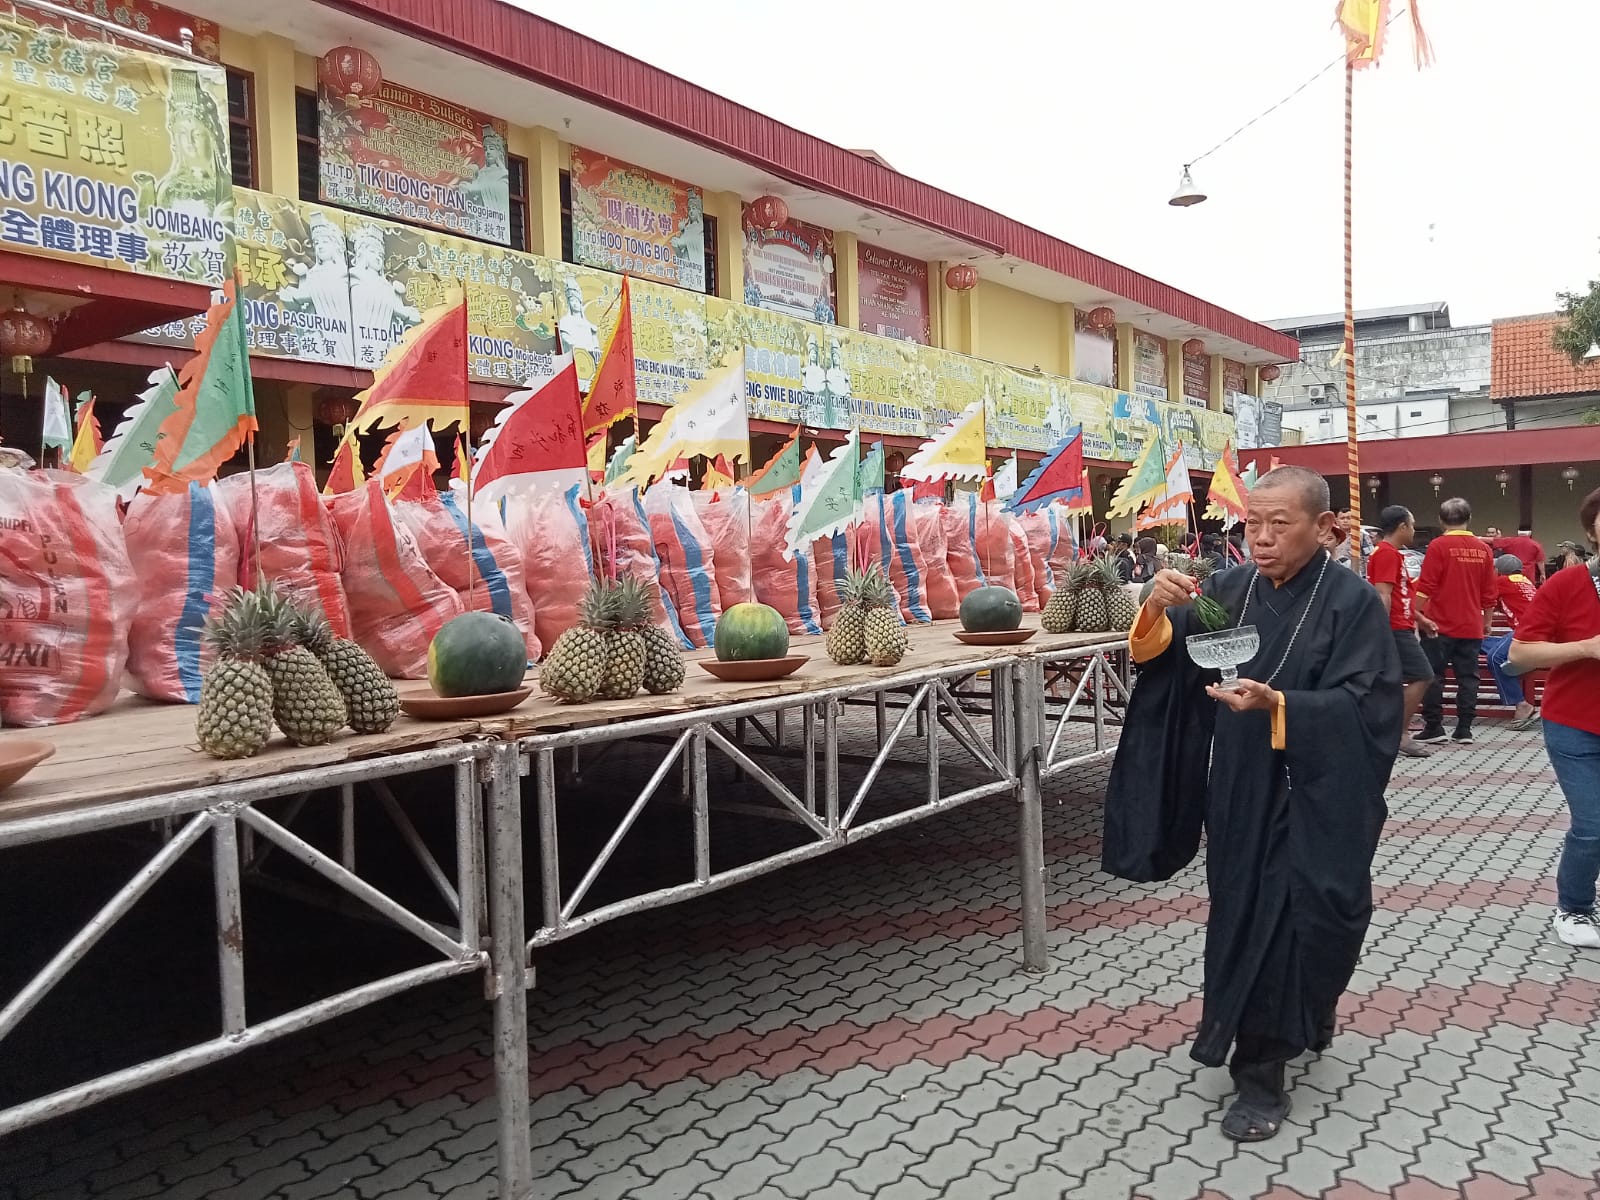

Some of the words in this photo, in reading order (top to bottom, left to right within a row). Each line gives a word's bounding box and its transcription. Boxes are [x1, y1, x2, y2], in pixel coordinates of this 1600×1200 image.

[0, 58, 140, 115] 聖誕志慶
[358, 164, 385, 188] TIK
[386, 172, 429, 200] LIONG
[433, 186, 466, 211] TIAN
[44, 170, 138, 224] KIONG
[146, 206, 224, 242] JOMBANG
[162, 242, 225, 282] 敬賀
[600, 232, 622, 250] HOO
[624, 236, 652, 258] TONG
[654, 244, 671, 263] BIO
[283, 310, 347, 335] PASURUAN
[469, 336, 513, 359] KIONG
[764, 384, 786, 403] SWIE
[788, 389, 803, 405] BIO
[877, 403, 896, 419] KIONG
